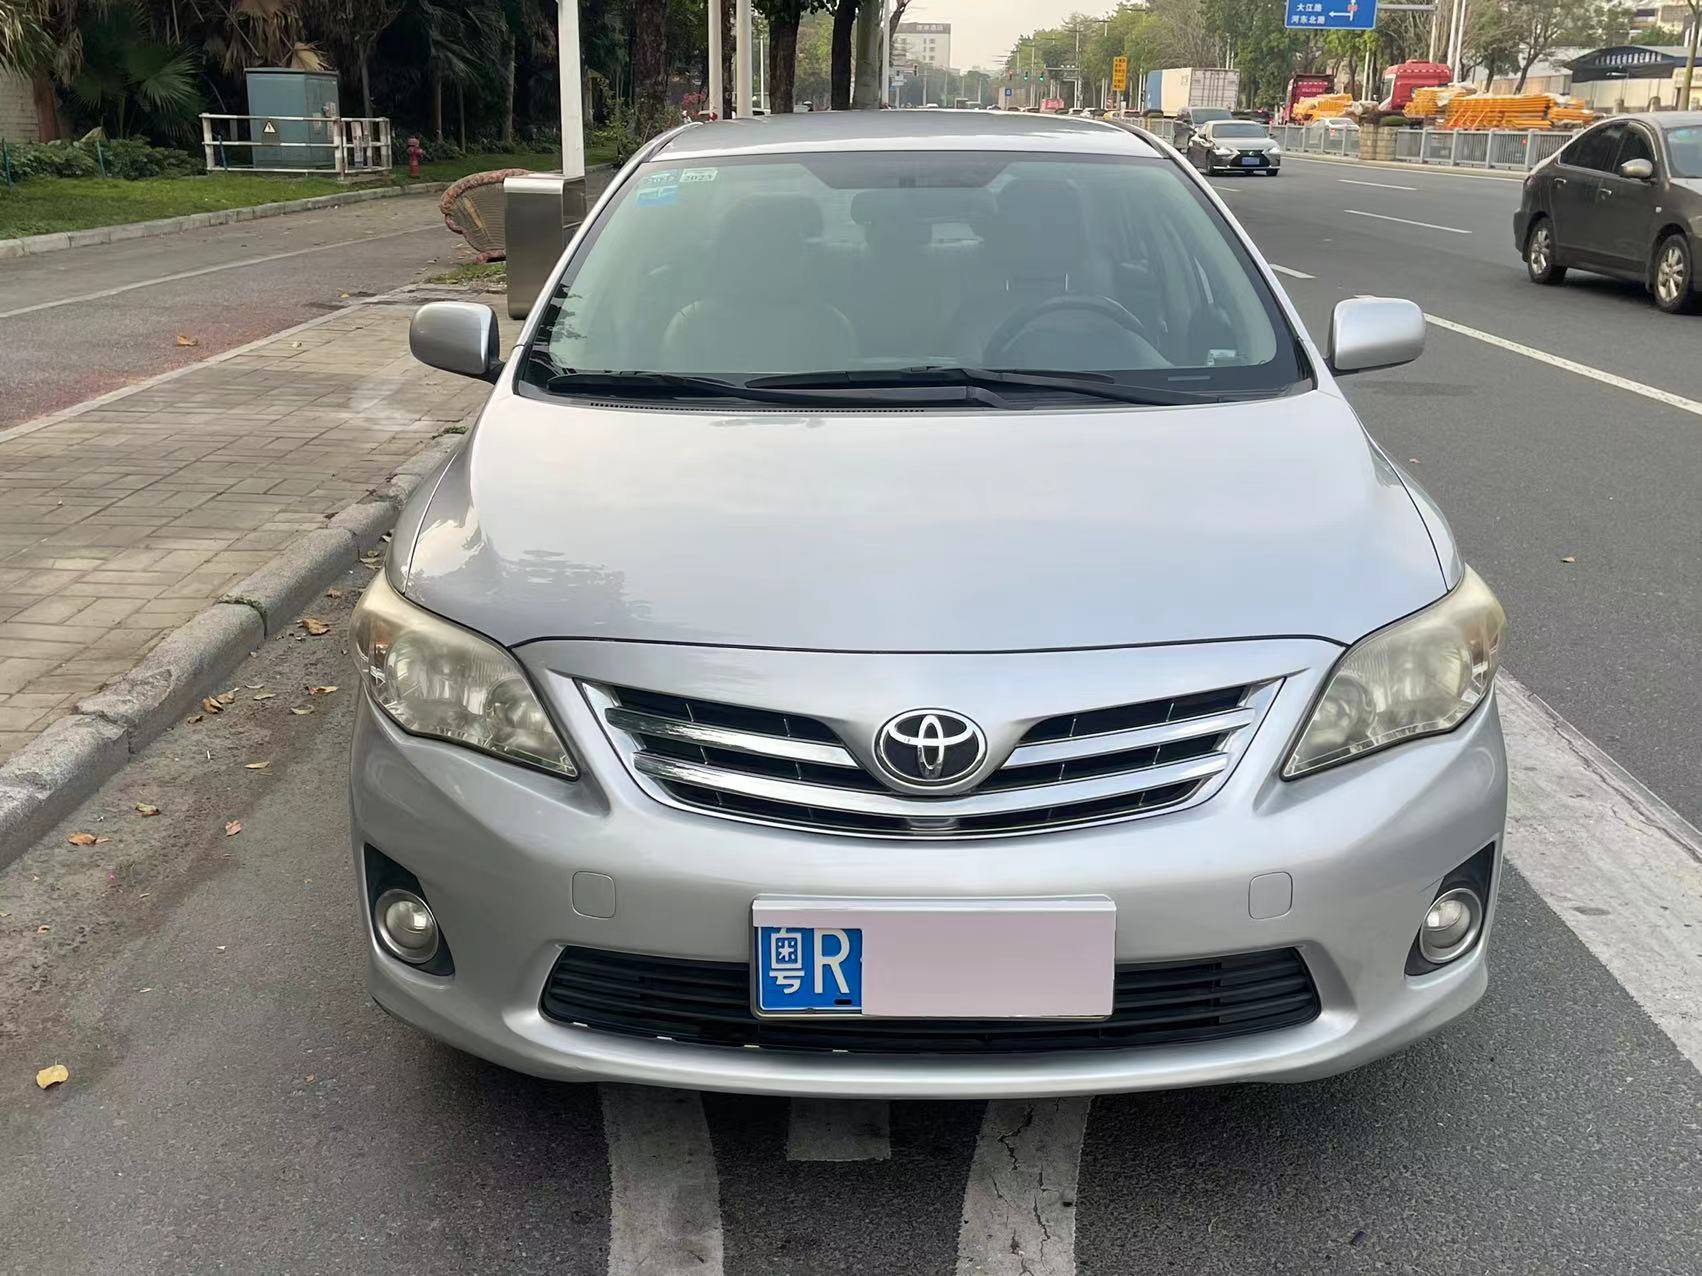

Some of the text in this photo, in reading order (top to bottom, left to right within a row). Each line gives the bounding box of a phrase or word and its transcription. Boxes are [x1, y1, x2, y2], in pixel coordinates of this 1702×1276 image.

[1296, 3, 1322, 12] 大江路
[1290, 15, 1326, 24] 河东北路
[769, 927, 850, 994] 粤R
